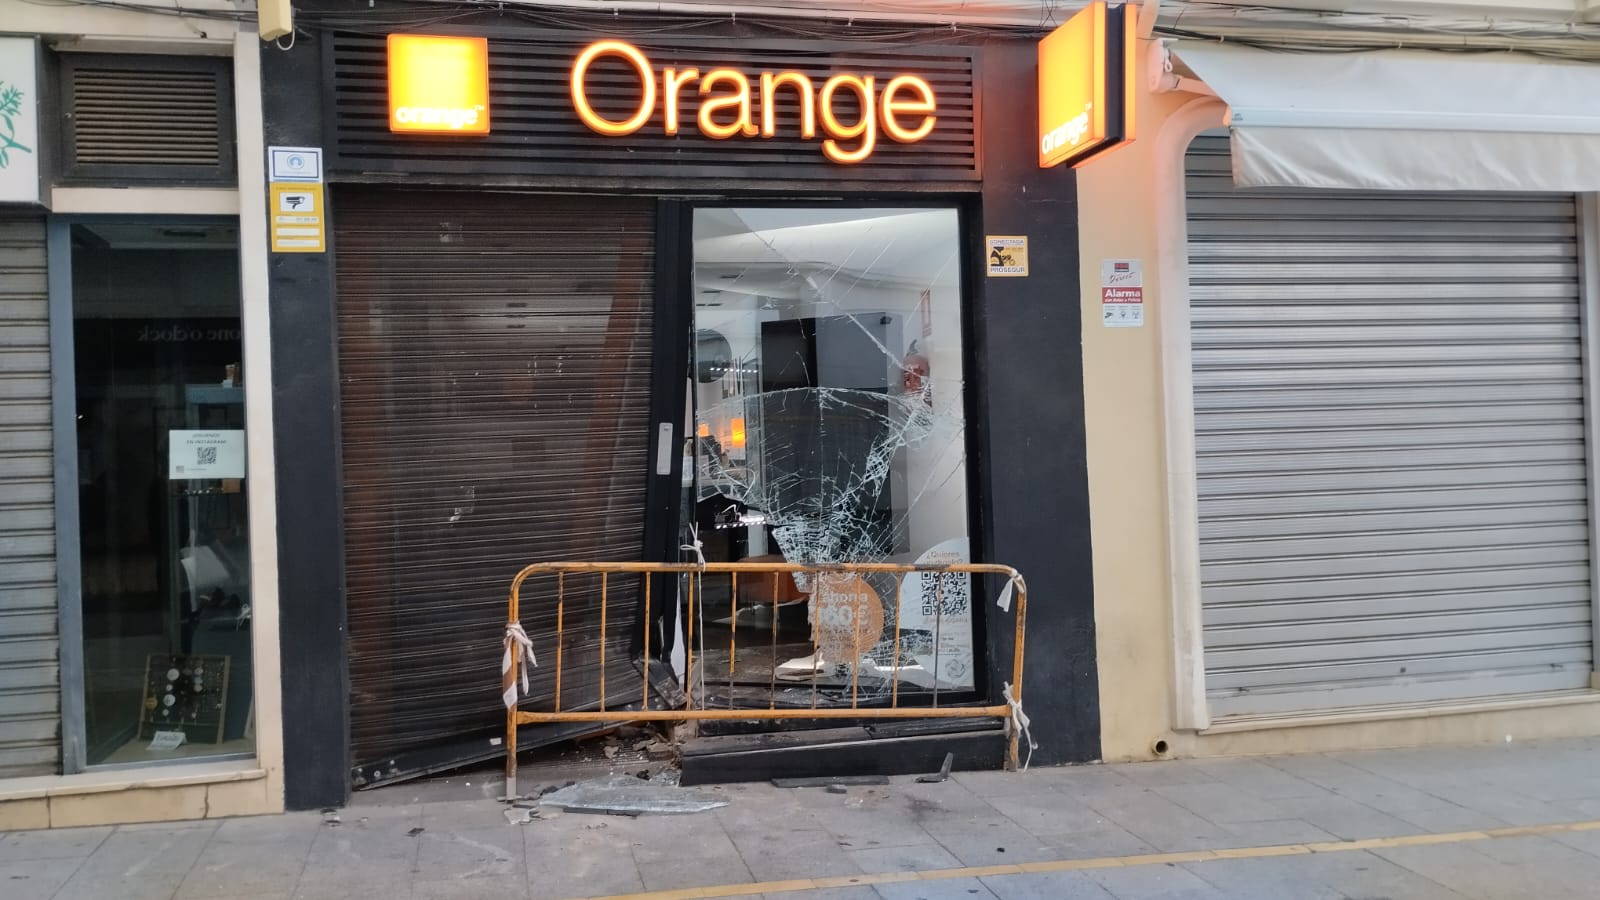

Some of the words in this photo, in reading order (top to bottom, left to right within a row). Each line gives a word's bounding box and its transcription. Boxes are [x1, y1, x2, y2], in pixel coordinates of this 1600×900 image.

[395, 107, 478, 129] orange
[571, 40, 937, 164] Orange
[1041, 111, 1089, 155] orange
[1104, 288, 1141, 298] Alarma
